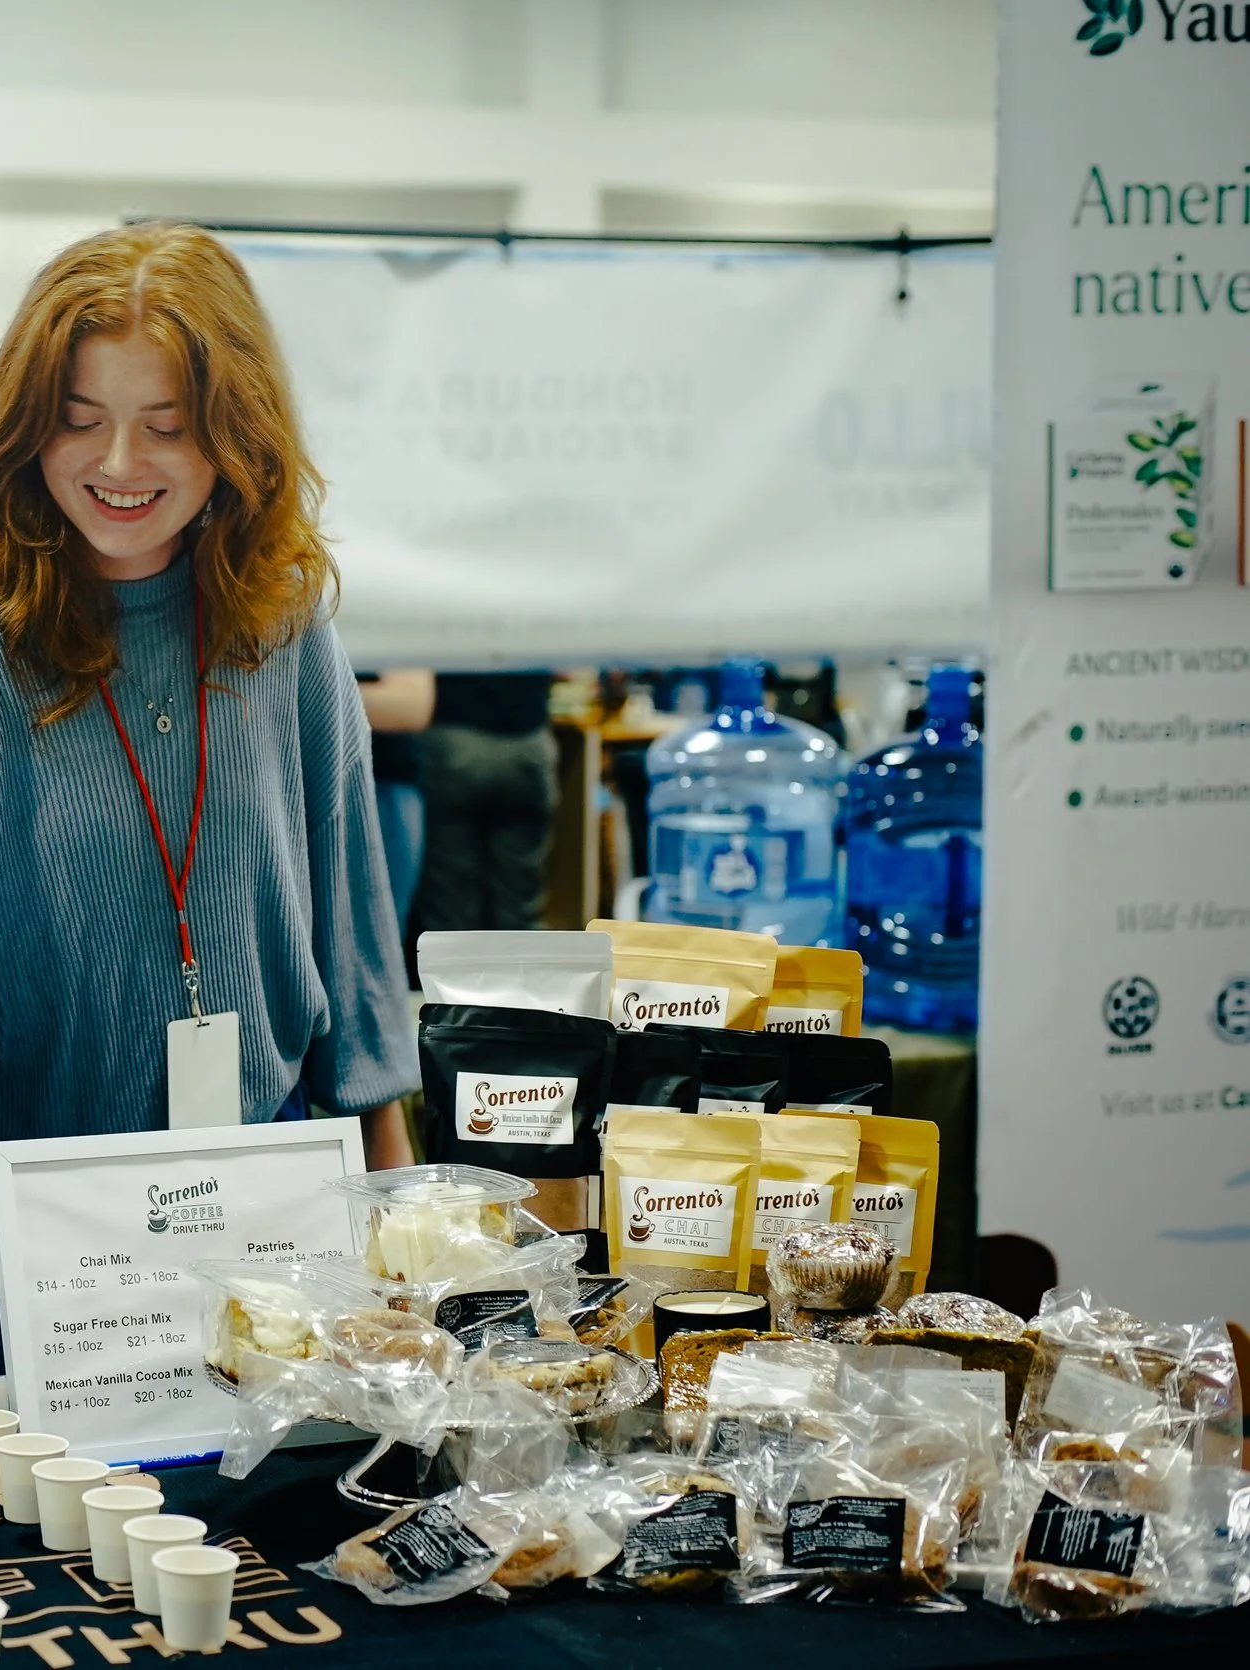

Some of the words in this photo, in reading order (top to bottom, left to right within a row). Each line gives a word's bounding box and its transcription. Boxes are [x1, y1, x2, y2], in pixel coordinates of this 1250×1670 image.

[1074, 254, 1250, 315] native
[1066, 650, 1174, 676] ANCIENT
[1096, 714, 1200, 747] Naturally
[474, 1081, 565, 1115] Sorrento's
[147, 1176, 219, 1216] Sorrento's
[632, 1185, 724, 1221] Sorrento's
[756, 1188, 820, 1211] rrento's
[172, 1205, 224, 1221] COFFEE
[173, 1224, 199, 1235] DRIVE
[202, 1222, 225, 1232] THRU
[664, 1219, 710, 1236] CHAI
[247, 1241, 295, 1253] Pastries
[663, 1237, 688, 1247] AUSTIN,
[689, 1239, 709, 1248] TEXAS
[80, 1255, 107, 1267] Chai
[110, 1254, 132, 1265] Mix
[36, 1280, 58, 1293] $14
[69, 1278, 97, 1290] 10oz
[119, 1273, 141, 1286] $20
[152, 1271, 180, 1283] 18oz
[53, 1320, 88, 1334] Sugar
[91, 1317, 118, 1330] Free
[121, 1315, 149, 1327] Chai
[151, 1313, 172, 1324] Mix
[44, 1343, 66, 1356] $15
[77, 1340, 103, 1353] 10oz
[126, 1335, 148, 1348] $21
[159, 1333, 186, 1345] 18oz
[45, 1378, 92, 1391] Mexican
[95, 1374, 133, 1388] Vanilla
[136, 1370, 171, 1382] Cocoa
[174, 1367, 193, 1378] Mix
[50, 1400, 71, 1412] $14
[83, 1397, 111, 1410] 10oz
[134, 1391, 156, 1404] $20
[167, 1389, 193, 1401] 18oz
